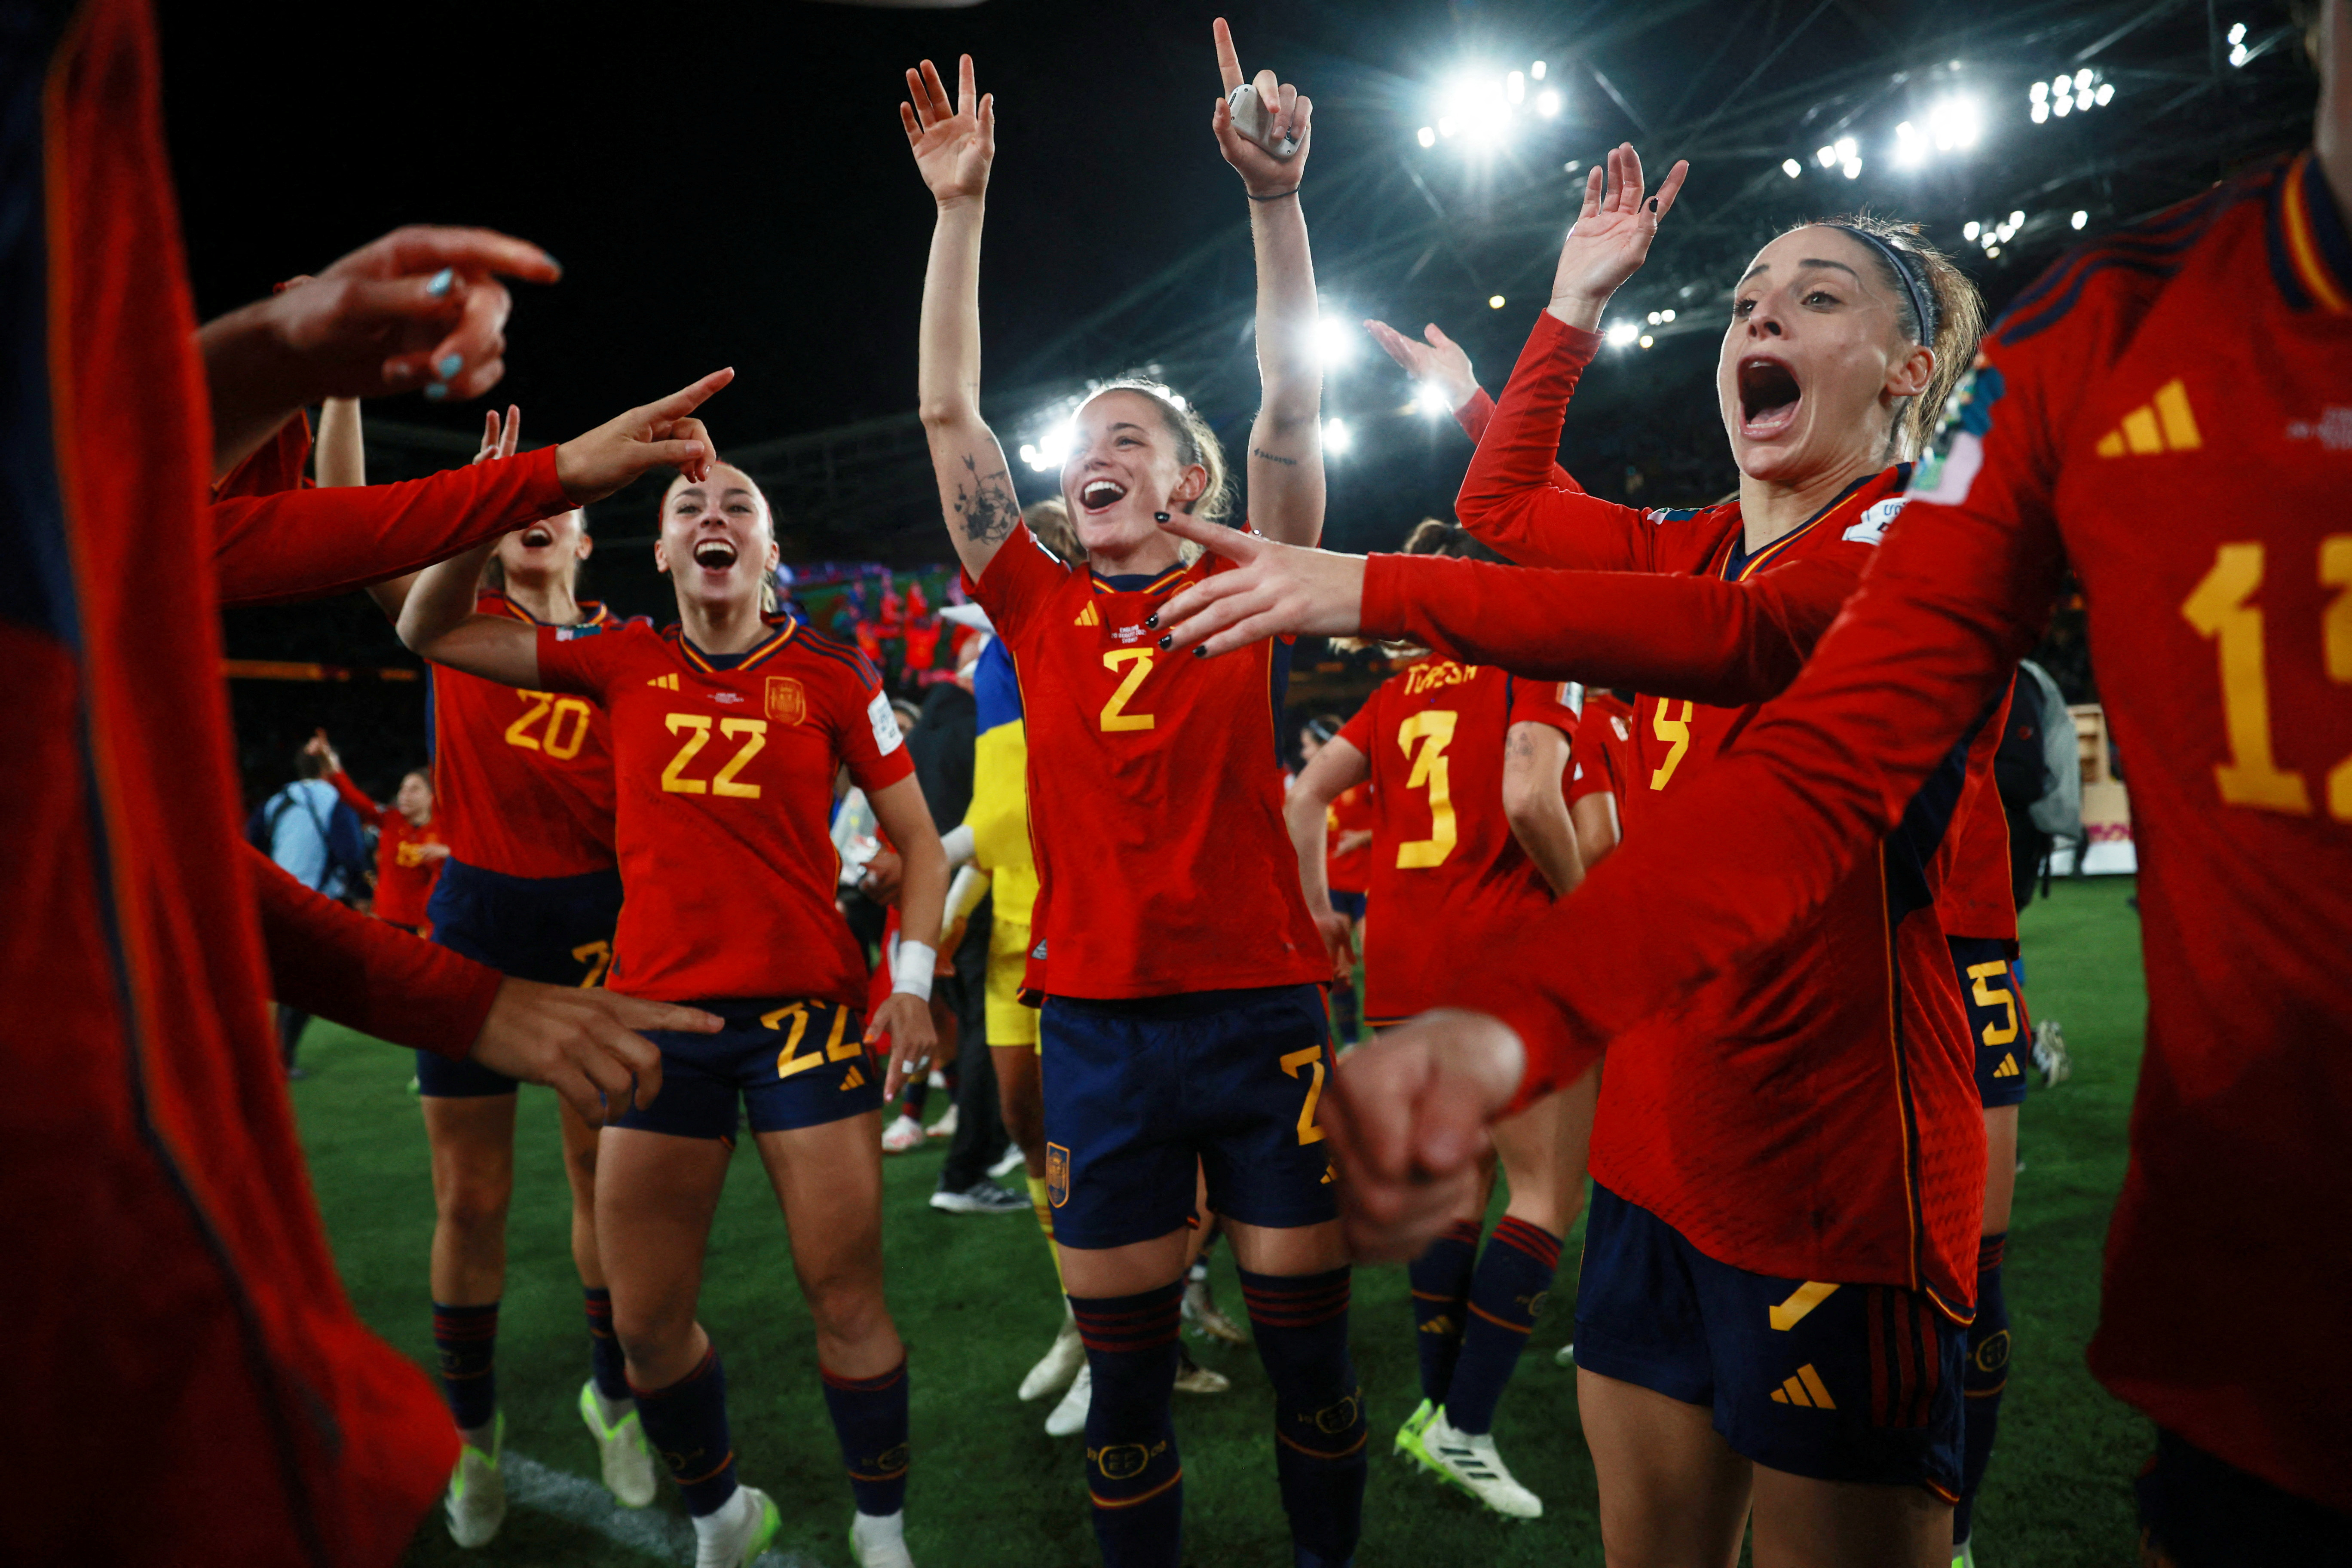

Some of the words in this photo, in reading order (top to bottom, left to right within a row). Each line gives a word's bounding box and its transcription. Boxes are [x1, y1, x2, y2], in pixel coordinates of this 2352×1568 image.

[505, 689, 591, 760] 20
[1100, 647, 1155, 732] 2
[661, 712, 768, 799] 22
[1396, 710, 1458, 869] 3
[760, 999, 861, 1079] 22
[1966, 959, 2019, 1047] 5
[1280, 1044, 1327, 1146] 2
